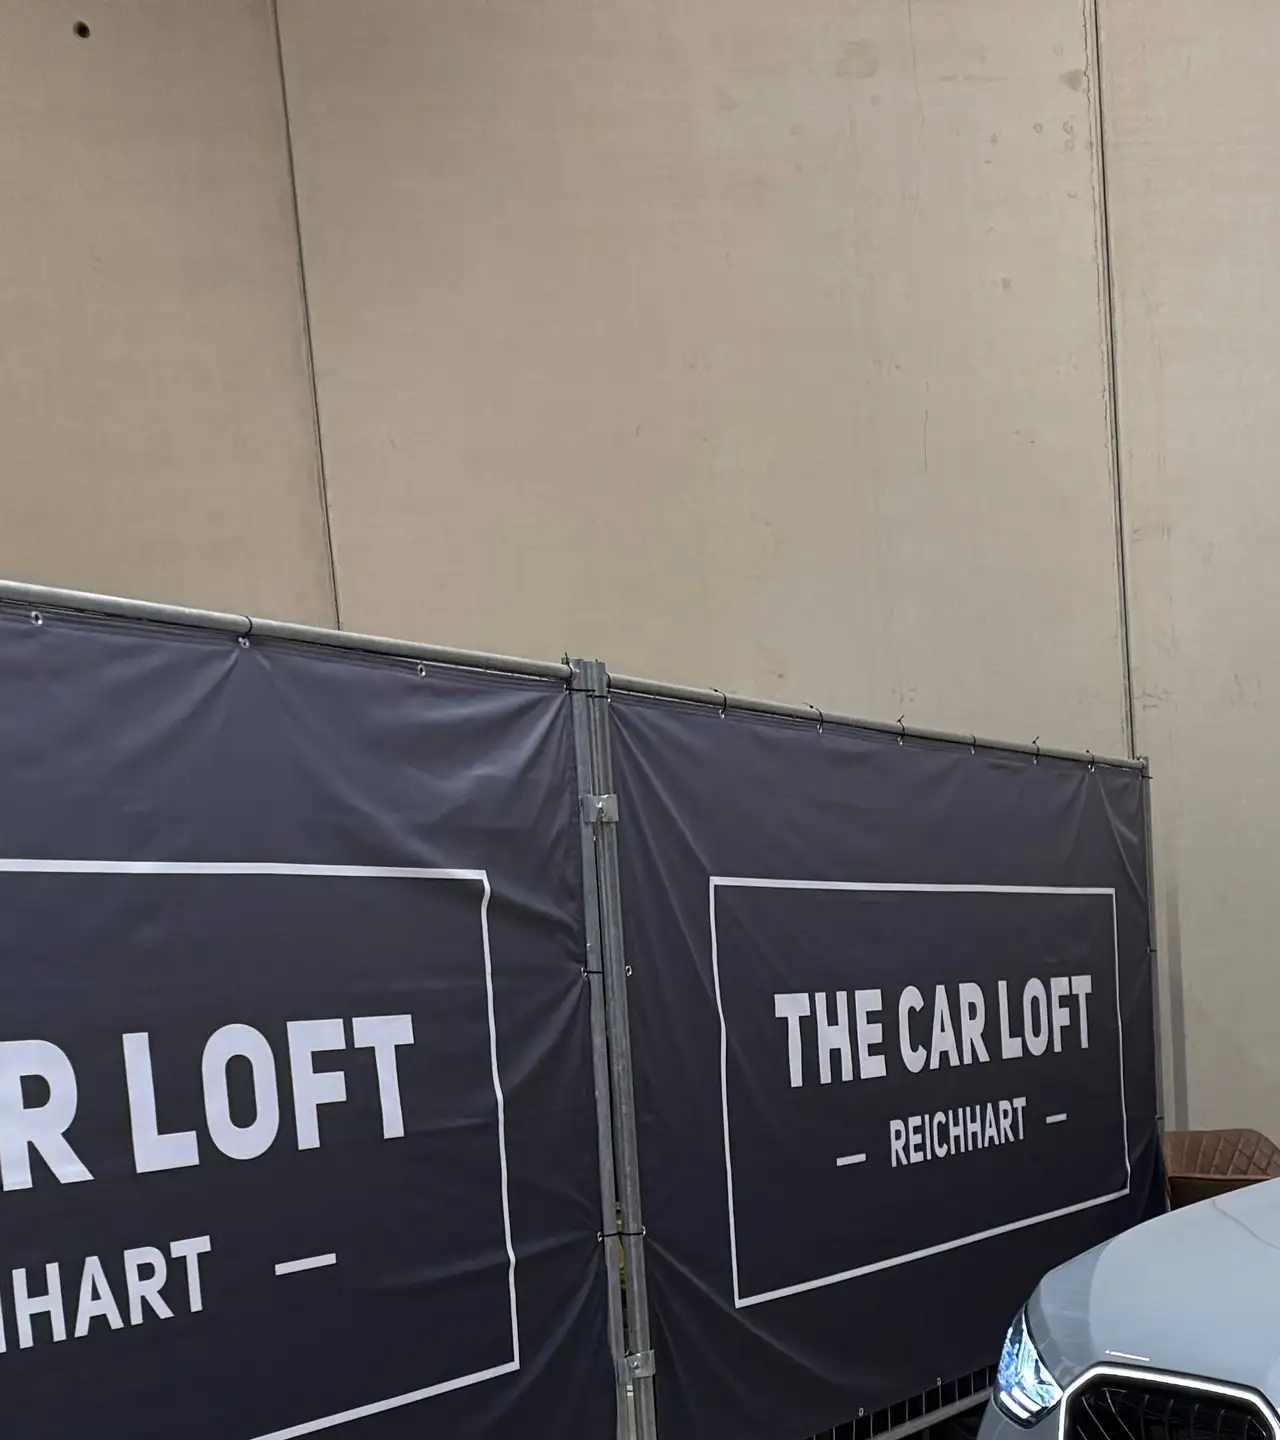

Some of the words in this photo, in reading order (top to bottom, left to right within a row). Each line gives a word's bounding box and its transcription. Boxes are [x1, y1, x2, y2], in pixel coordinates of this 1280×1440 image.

[774, 988, 887, 1088] THE
[898, 982, 990, 1073] CAR
[997, 974, 1092, 1060] LOFT
[122, 1013, 415, 1174] LOFT
[889, 1096, 1028, 1168] REICHHART
[0, 1234, 212, 1354] HART
